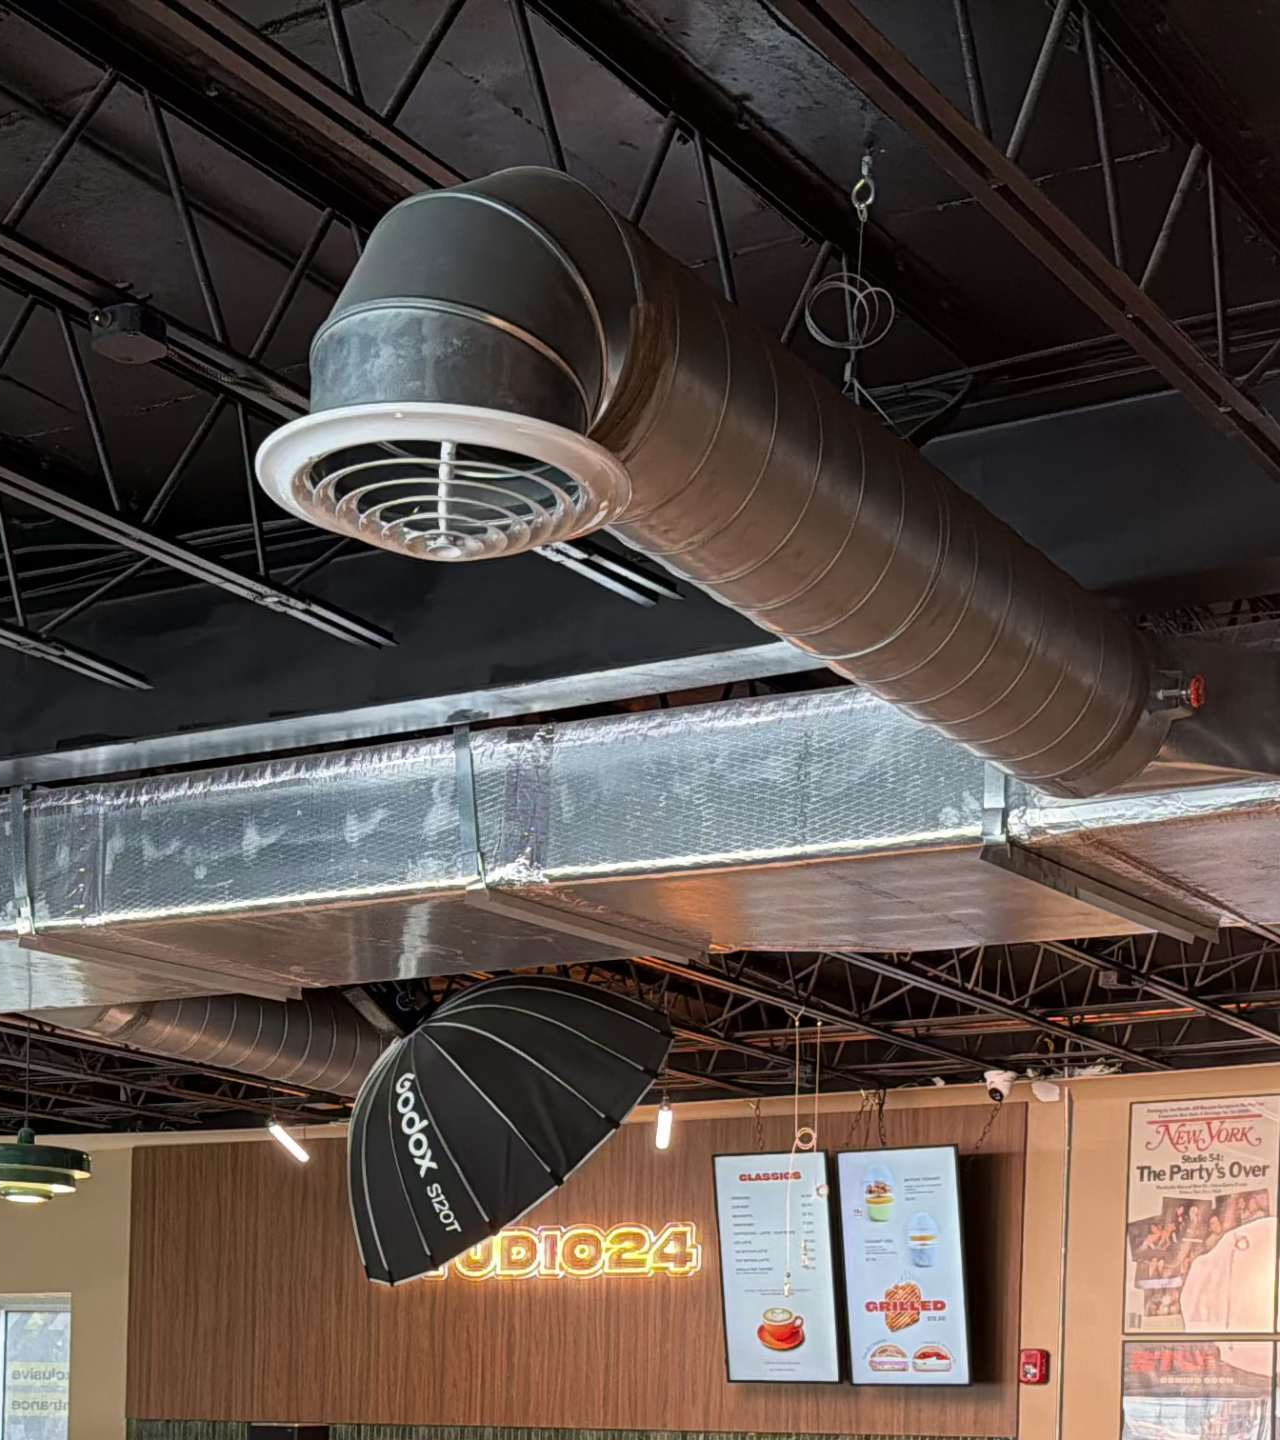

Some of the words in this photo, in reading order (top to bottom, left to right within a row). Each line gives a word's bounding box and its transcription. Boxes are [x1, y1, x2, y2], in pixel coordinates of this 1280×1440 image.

[395, 1072, 439, 1178] Godox
[426, 1183, 462, 1233] S120T
[1181, 1153, 1207, 1164] Studio
[738, 1171, 802, 1182] CLASSICS
[1136, 1165, 1166, 1182] The
[1169, 1163, 1226, 1183] Party's
[1229, 1161, 1270, 1178] Over
[423, 1222, 701, 1281] UDIO24
[864, 1300, 947, 1312] GRILLED
